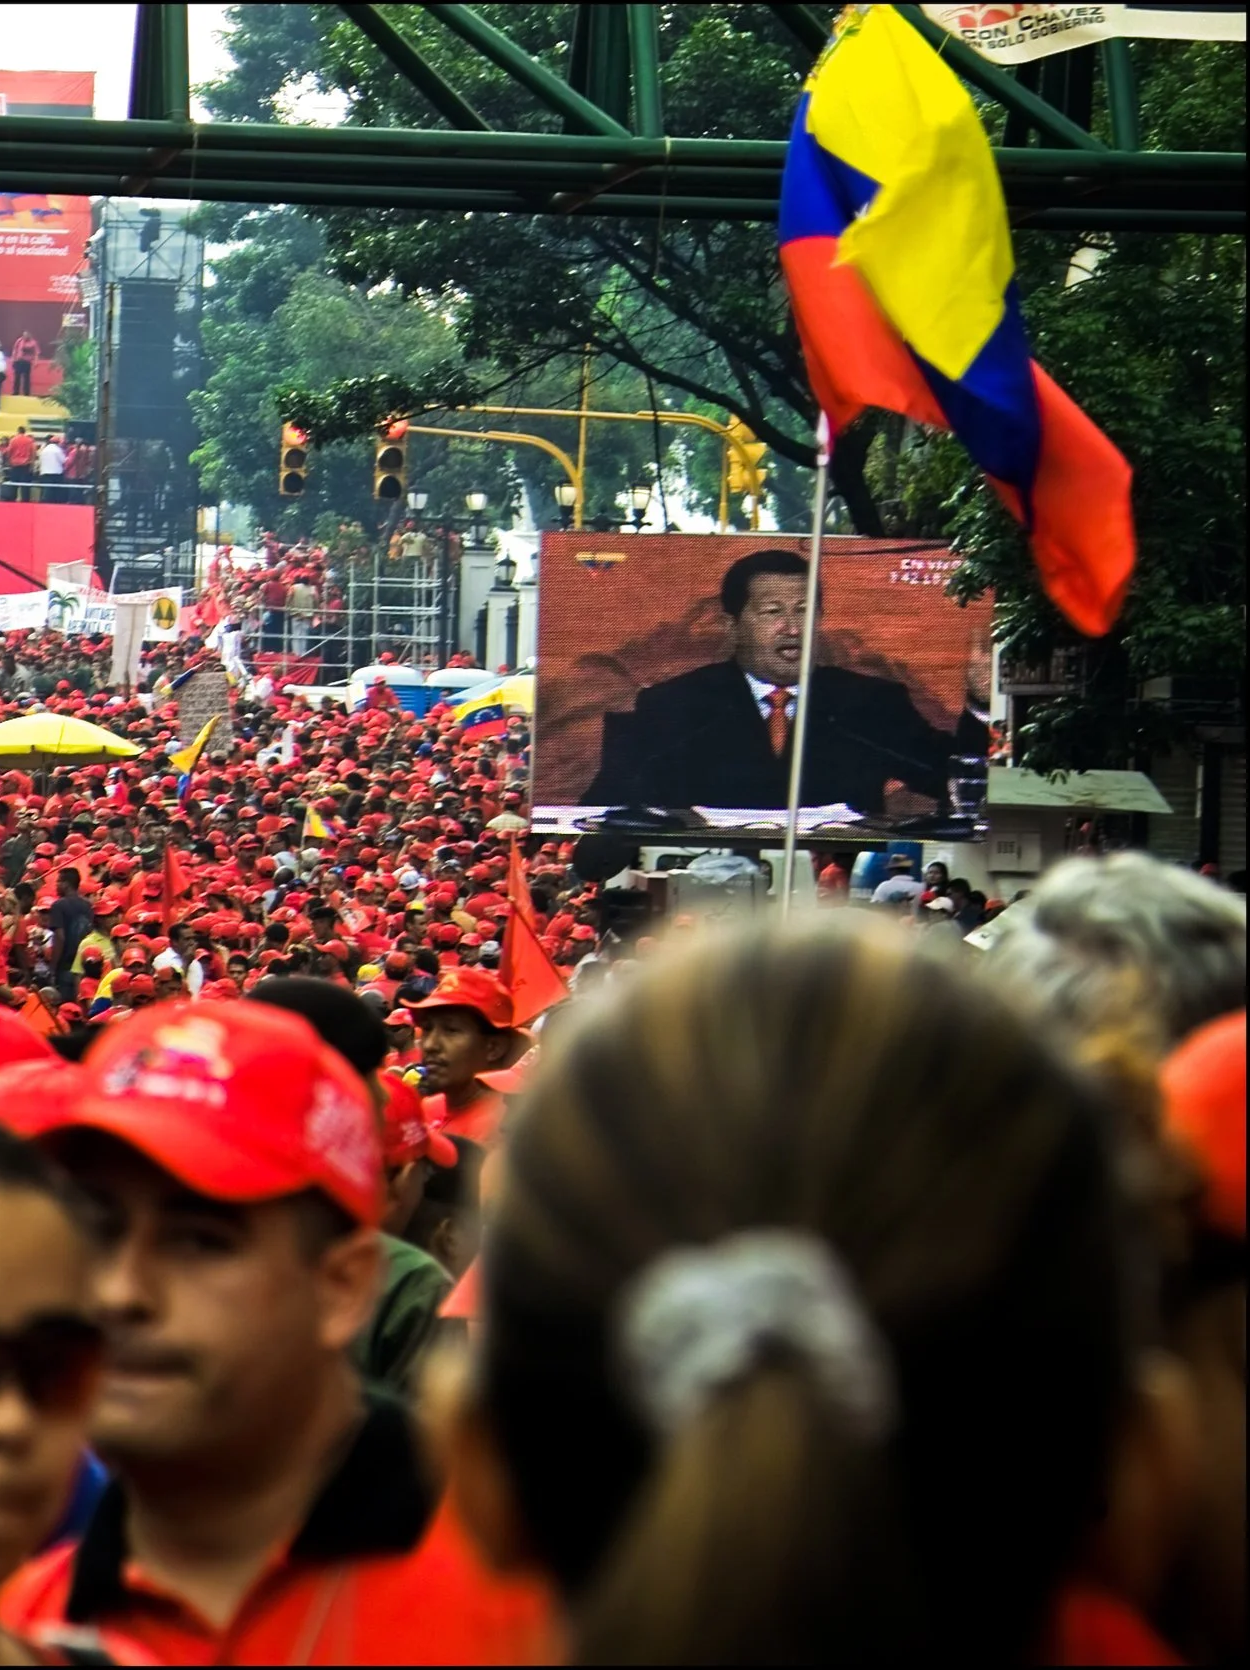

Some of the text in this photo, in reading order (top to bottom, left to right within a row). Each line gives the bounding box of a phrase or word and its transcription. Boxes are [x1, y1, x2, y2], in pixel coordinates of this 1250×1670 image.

[961, 6, 1104, 40] CON CHAVEZ
[987, 33, 1026, 49] SOLO
[1030, 15, 1106, 40] GOBIERNO
